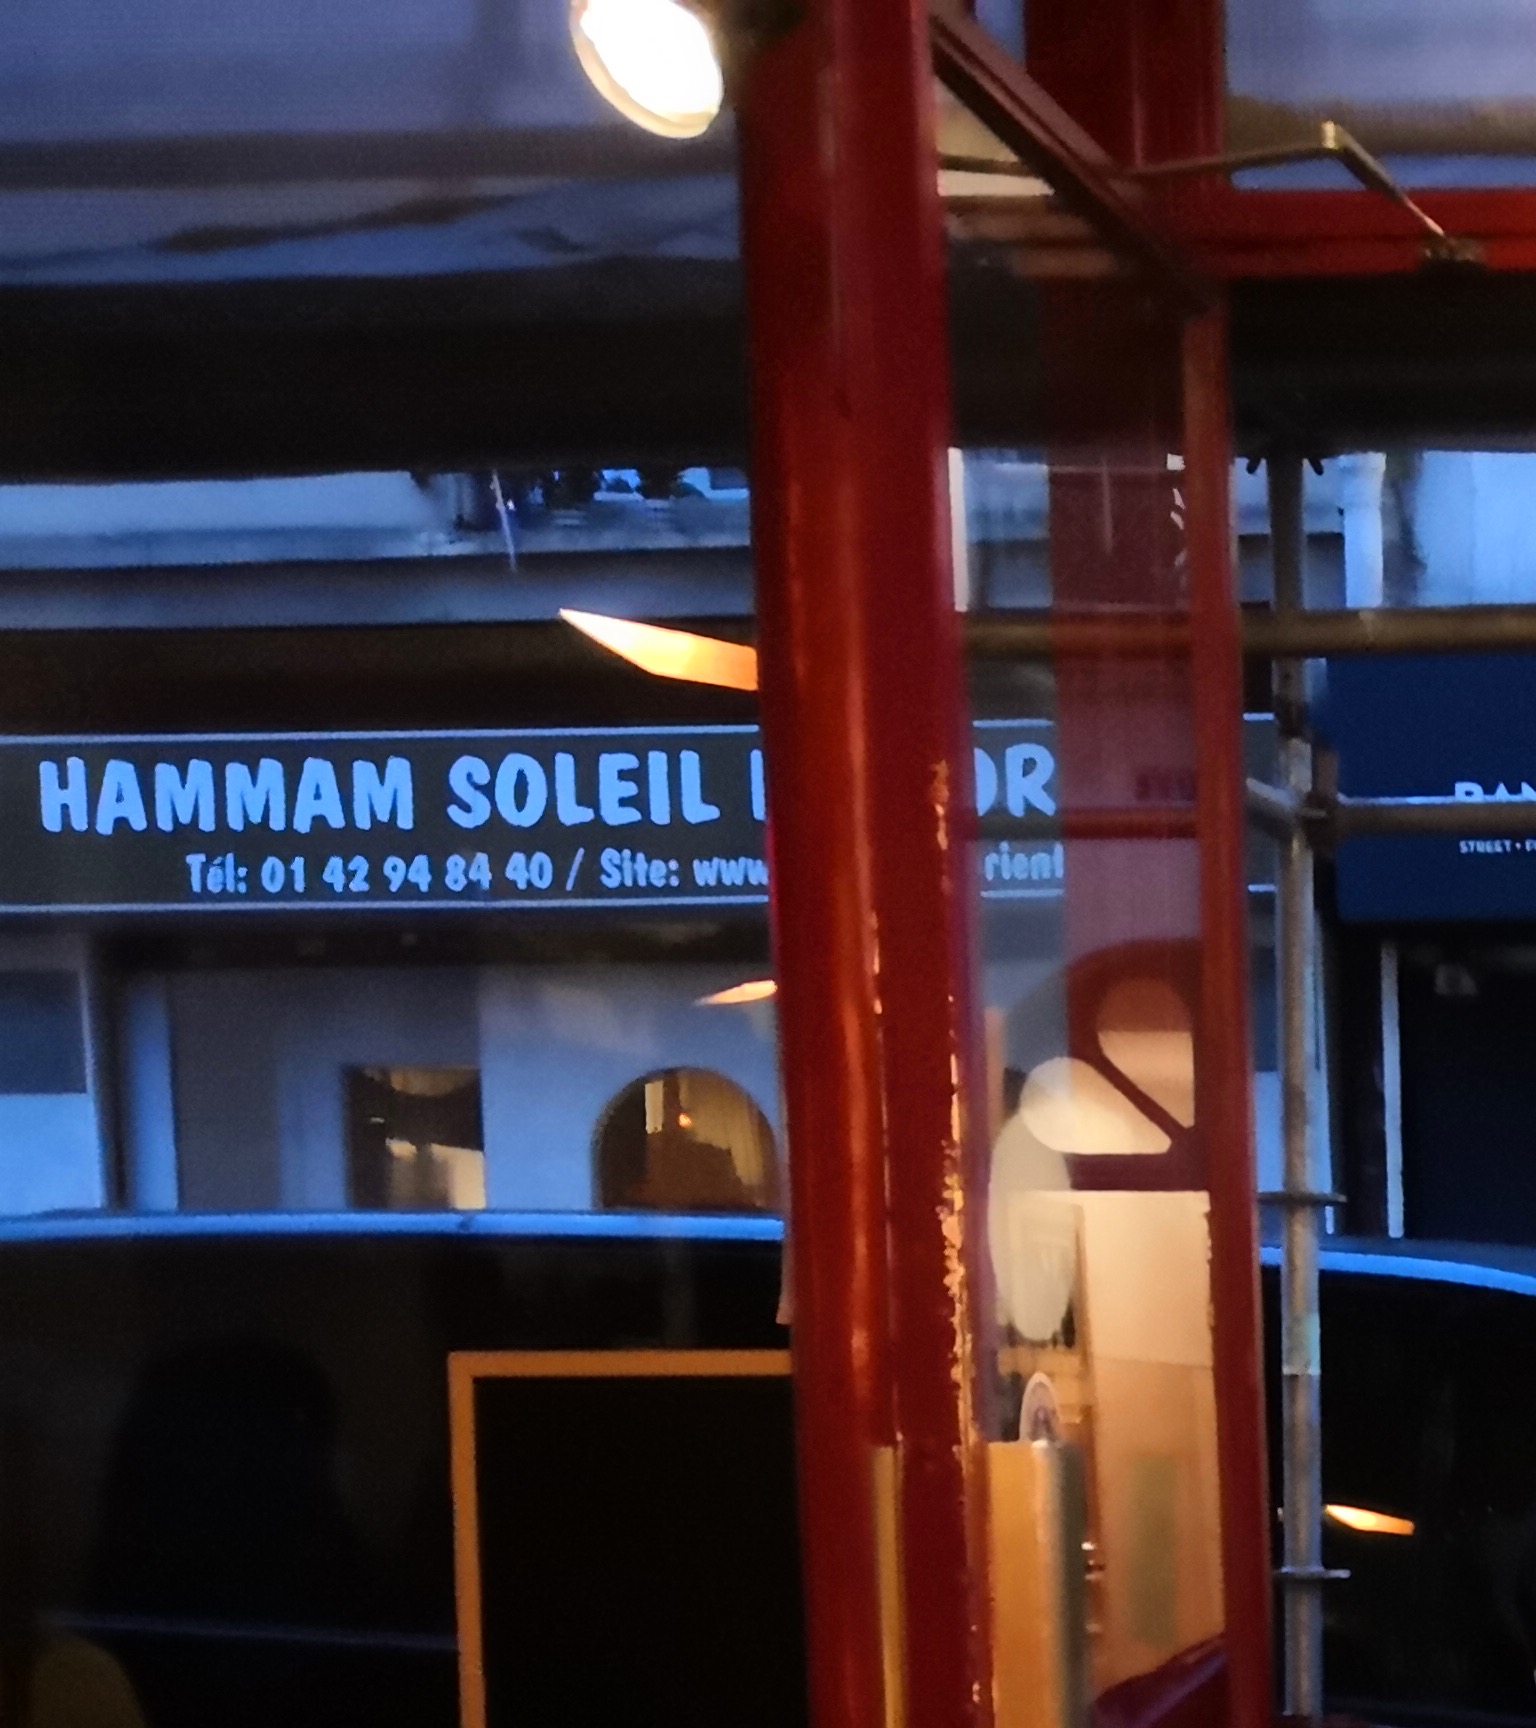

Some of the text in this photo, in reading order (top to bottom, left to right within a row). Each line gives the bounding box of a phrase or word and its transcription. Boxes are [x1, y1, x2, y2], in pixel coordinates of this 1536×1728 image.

[38, 755, 415, 836] HAMMAM
[446, 749, 722, 829] SOLEIL
[261, 856, 306, 894] 01
[322, 855, 371, 894] 42
[383, 854, 433, 893] 94
[445, 852, 493, 893] 84
[505, 851, 554, 892] 40
[599, 846, 680, 891] Site:
[1459, 839, 1512, 854] STREET
